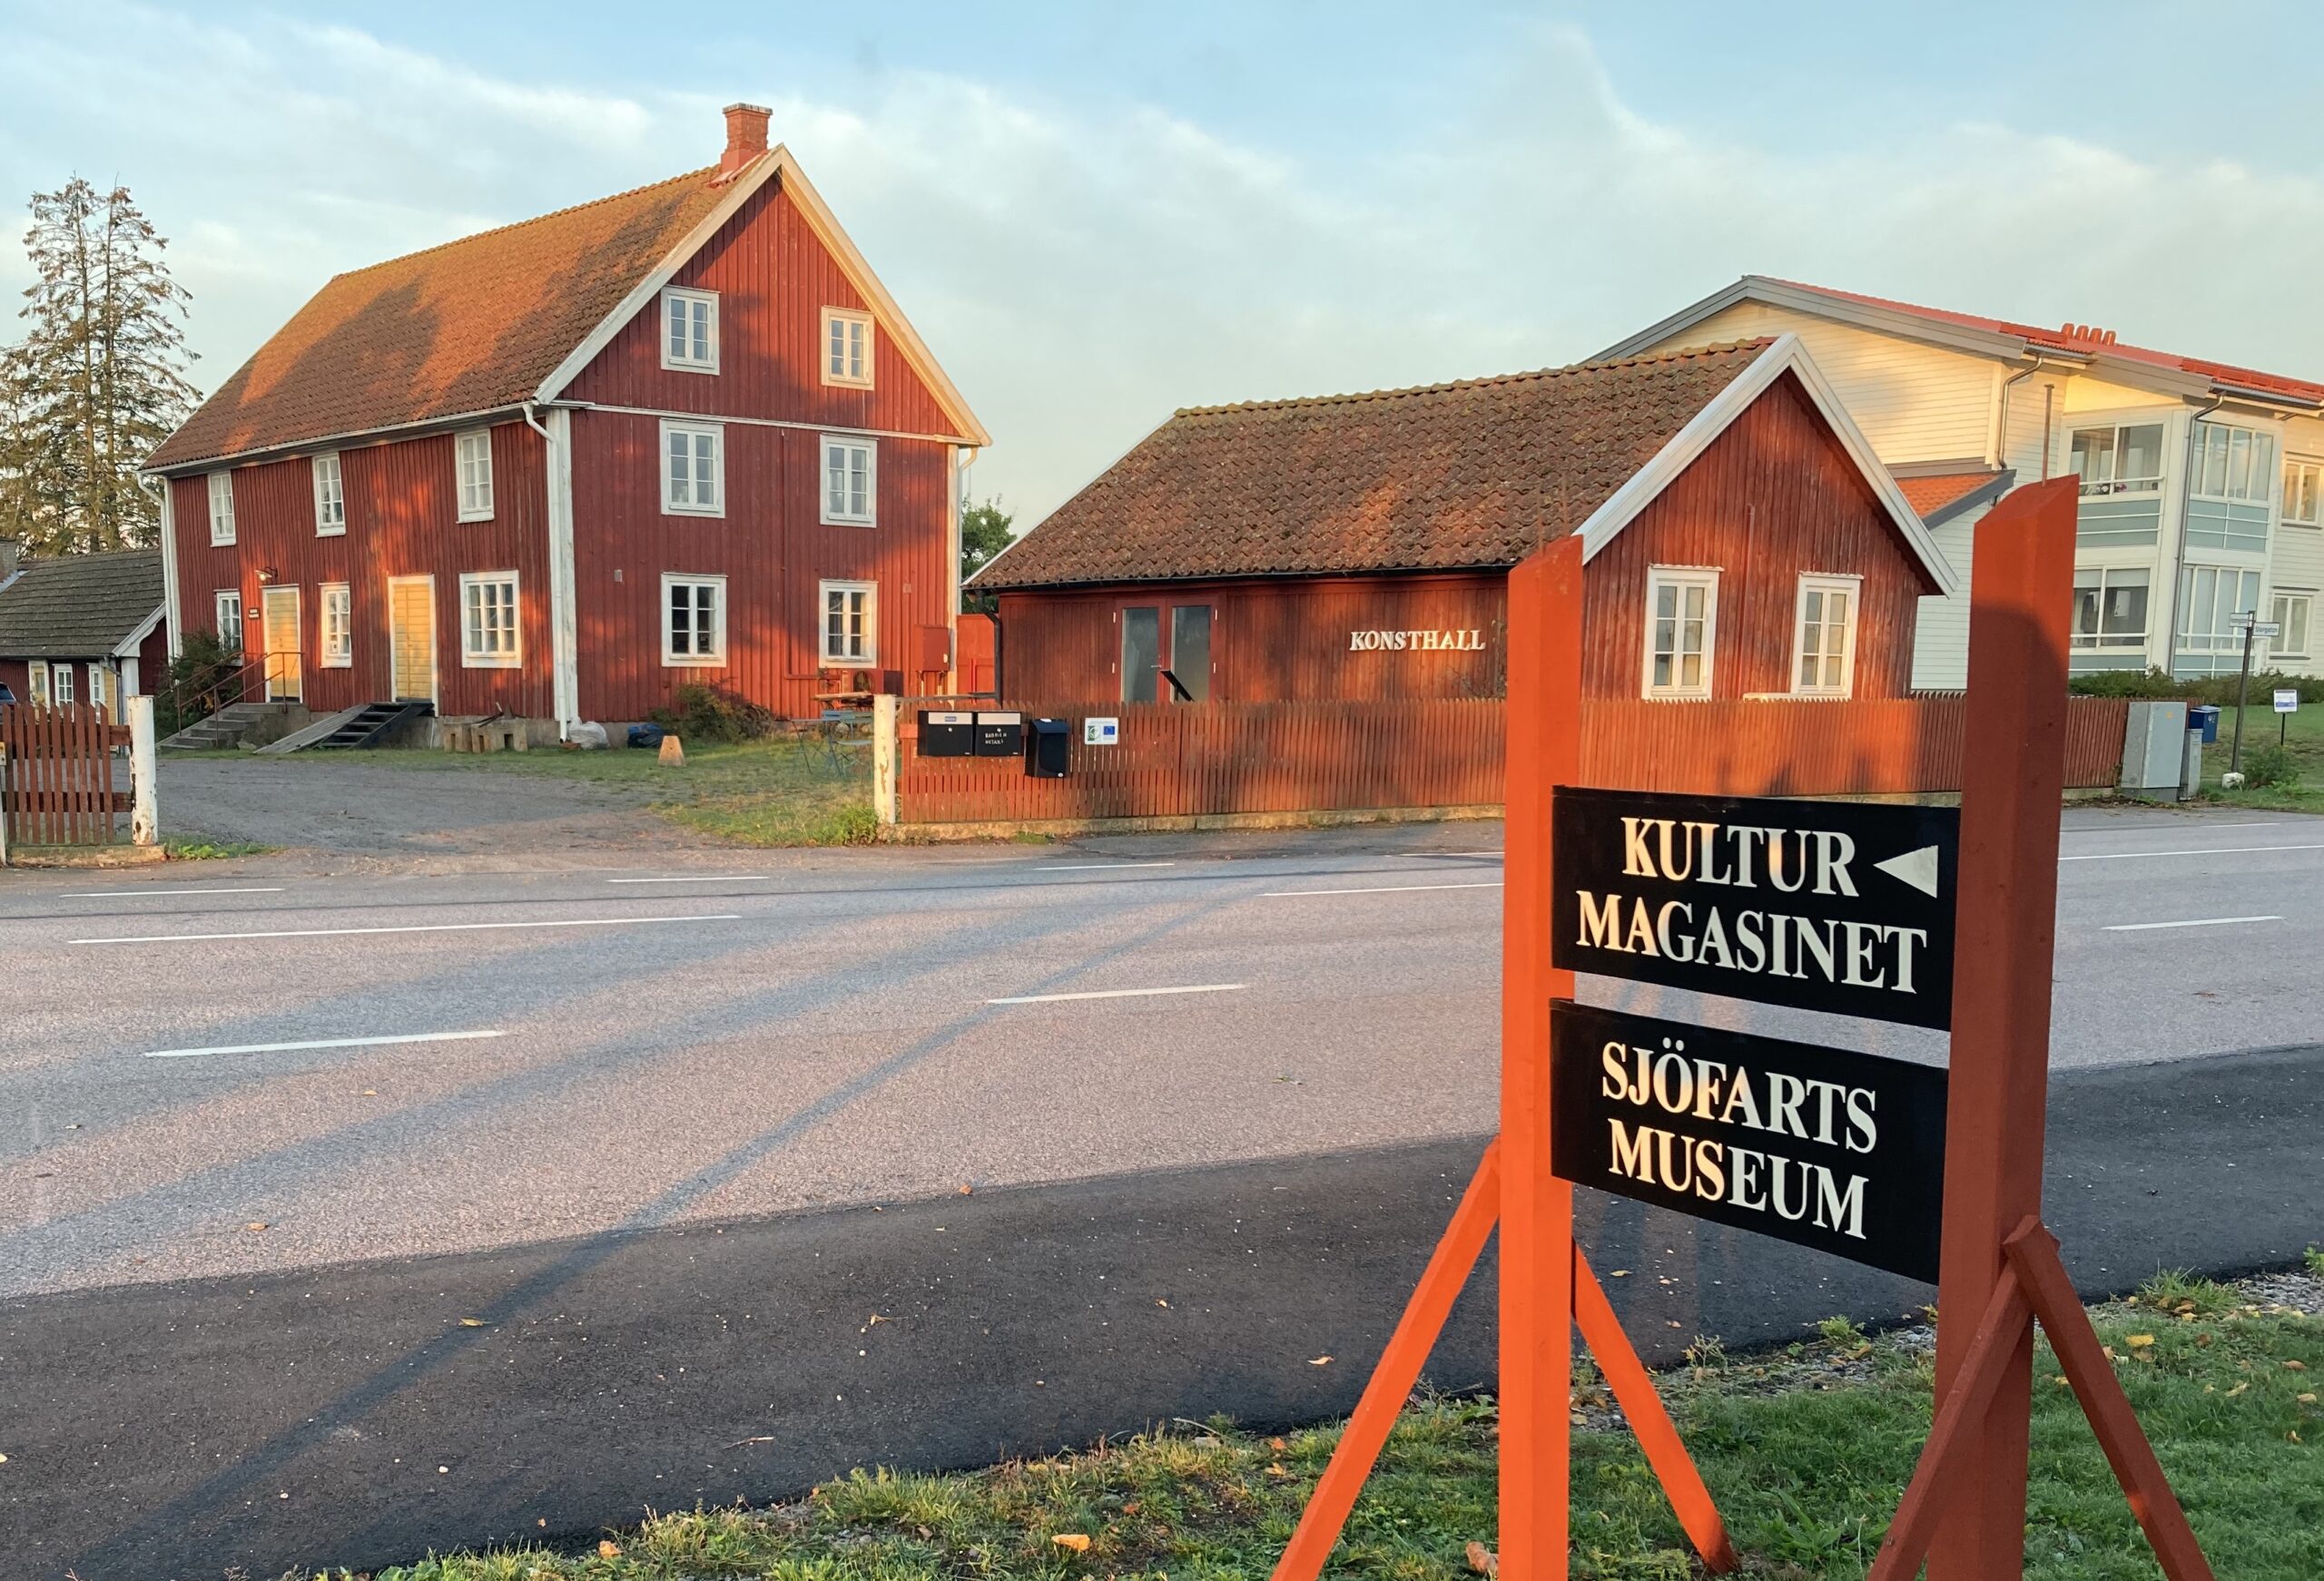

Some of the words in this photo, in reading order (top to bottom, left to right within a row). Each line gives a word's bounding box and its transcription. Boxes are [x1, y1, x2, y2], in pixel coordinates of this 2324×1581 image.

[1349, 630, 1486, 652] KONSTHALL
[1620, 817, 1860, 899] KULTUR
[1575, 889, 1928, 995] MAGASINET
[1601, 1037, 1877, 1154] SJÖFARTS
[1607, 1117, 1870, 1241] MUSEUM
